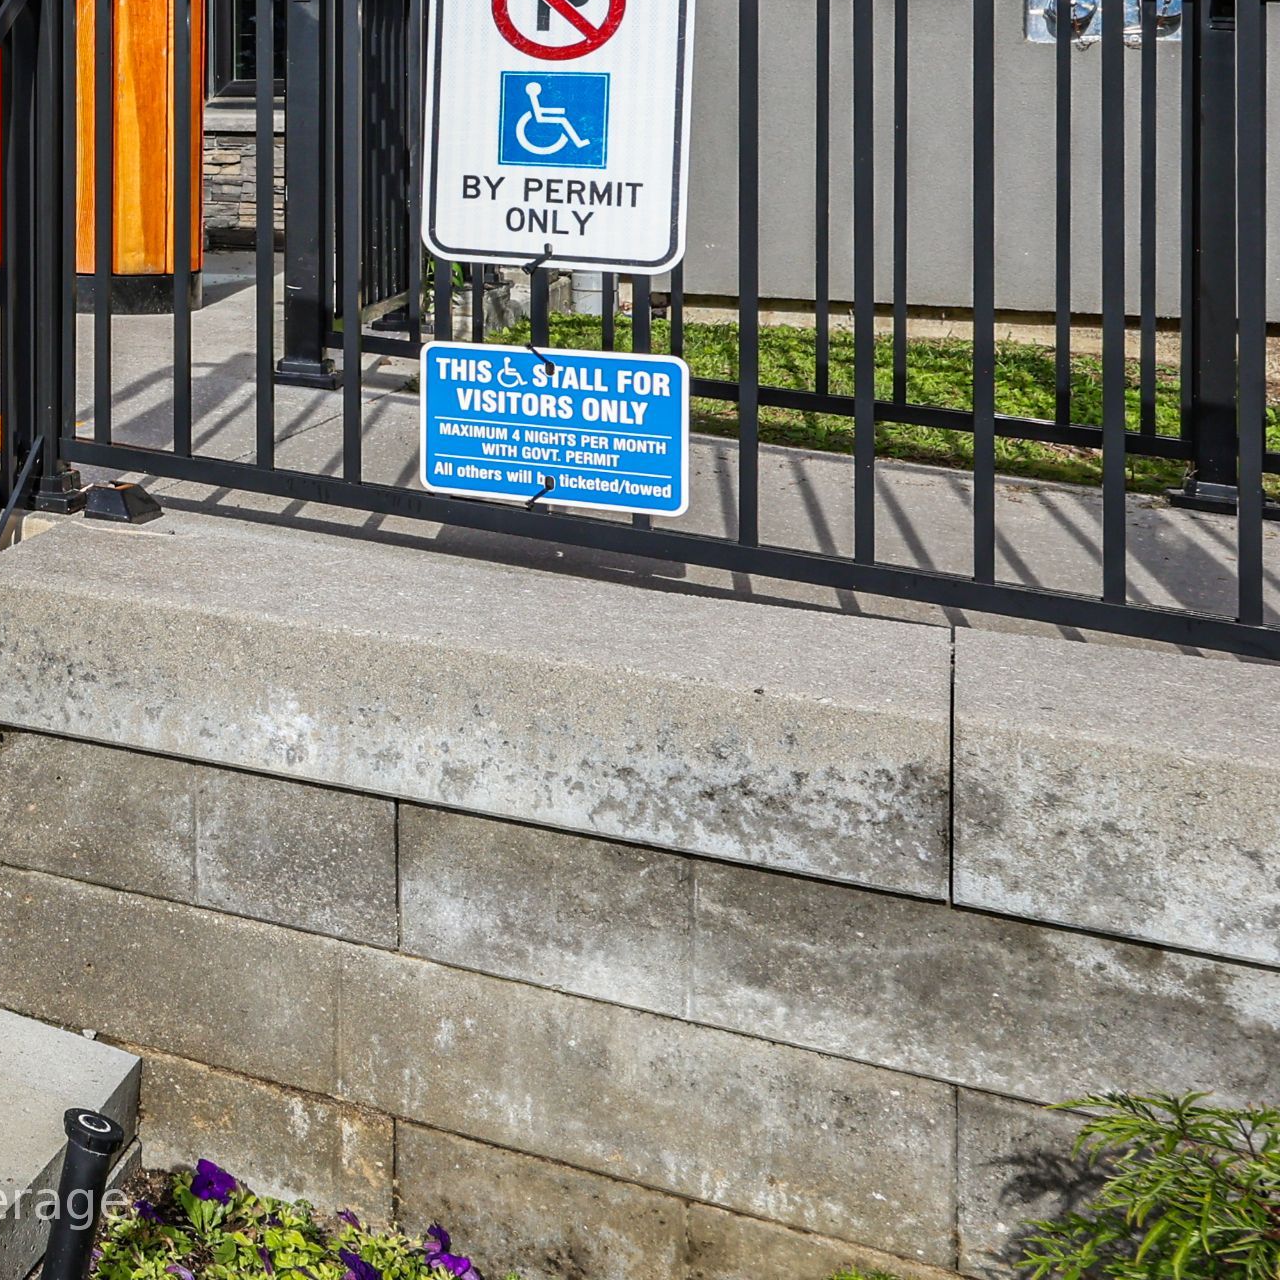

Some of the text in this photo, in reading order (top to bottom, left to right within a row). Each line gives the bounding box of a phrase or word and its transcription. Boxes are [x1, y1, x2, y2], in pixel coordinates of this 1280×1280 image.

[462, 174, 645, 208] BY PERMIT
[505, 207, 595, 237] ONLY
[435, 357, 671, 398] THIS STALL FOR
[456, 388, 648, 425] VISITORS ONLY
[439, 422, 667, 455] MAXIMUM 4 NIGHTS PER MONTH
[482, 442, 621, 468] WITH GOVT. PERMIT
[434, 460, 453, 476] All
[457, 464, 502, 481] others
[507, 469, 533, 485] will
[559, 473, 672, 499] ticketed/towed
